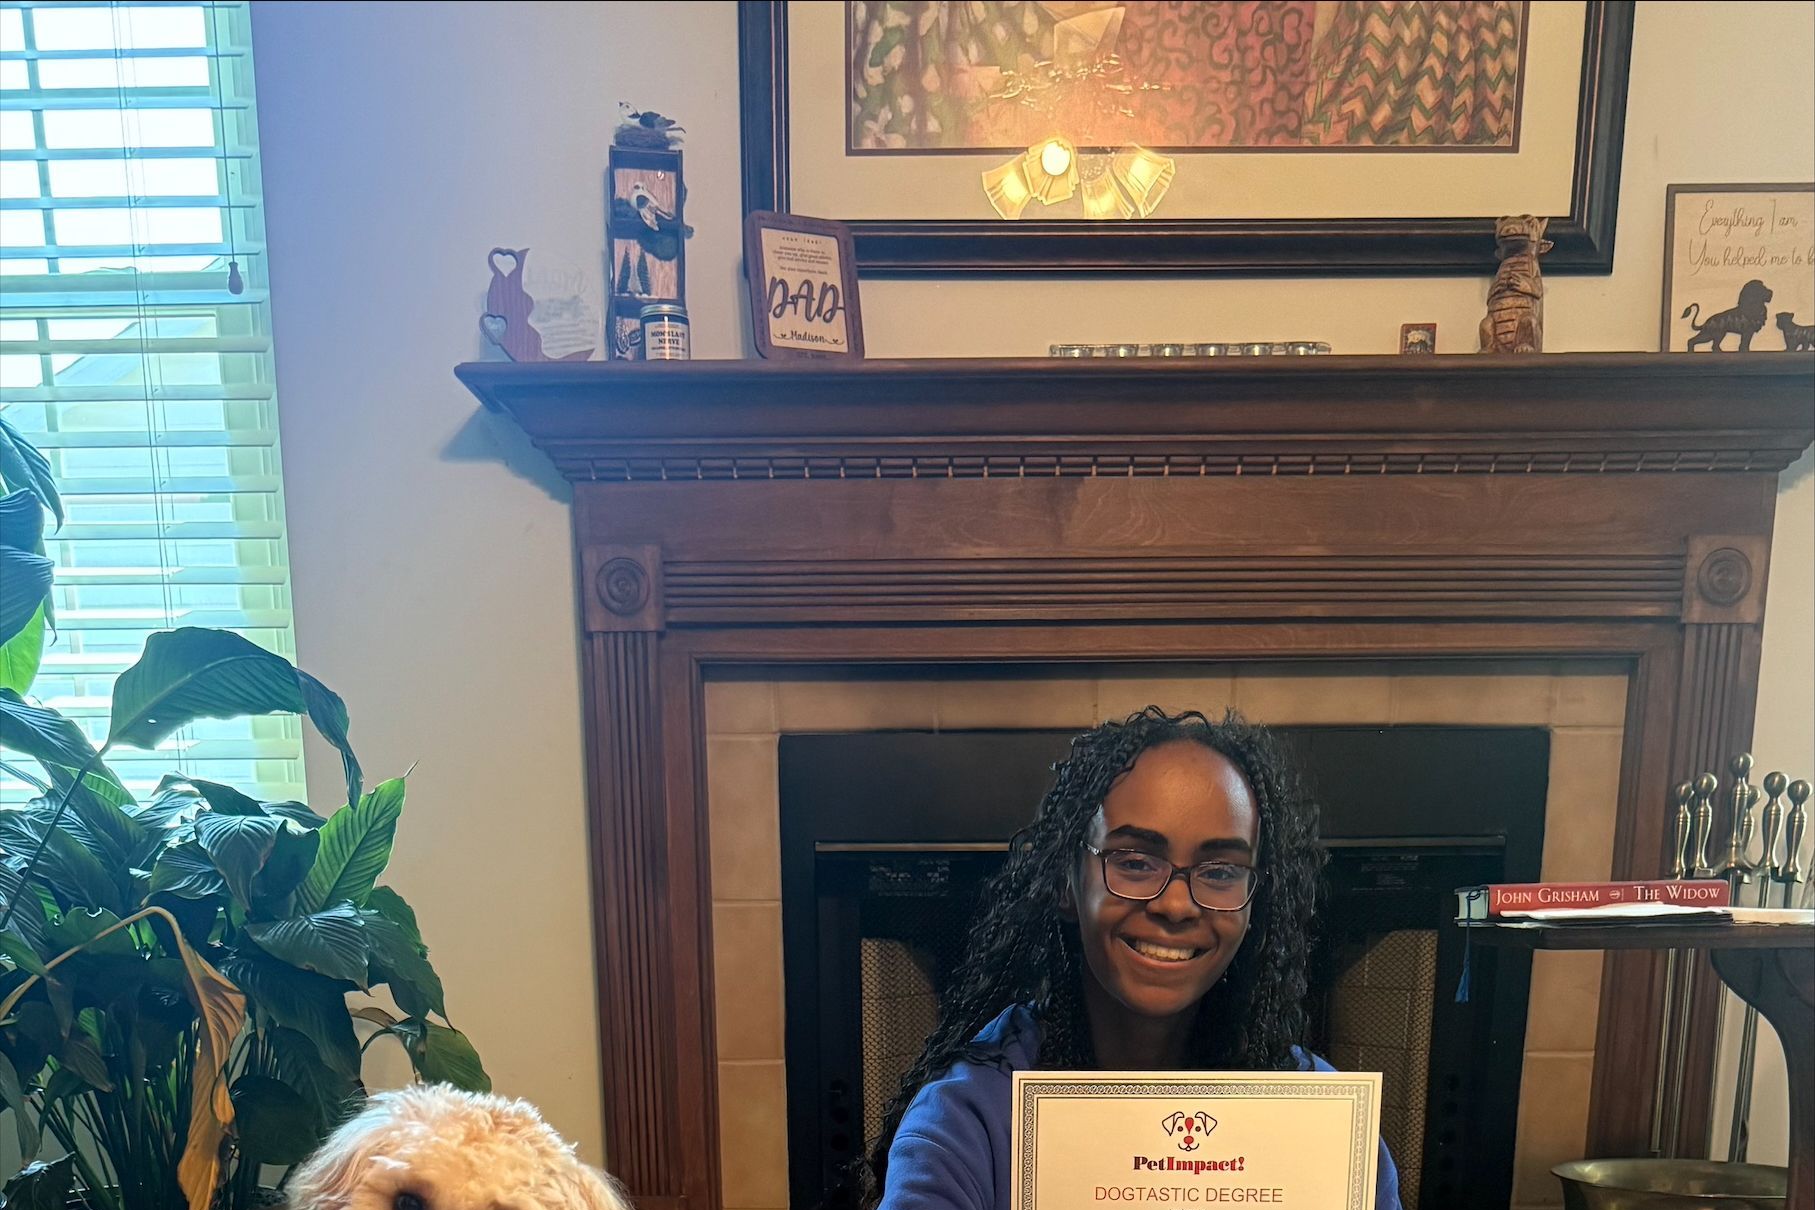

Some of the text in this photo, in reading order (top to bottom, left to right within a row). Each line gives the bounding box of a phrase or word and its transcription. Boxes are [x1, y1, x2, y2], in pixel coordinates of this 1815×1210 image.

[1698, 199, 1765, 238] Everything
[1779, 216, 1799, 228] am
[1689, 239, 1720, 276] You
[1723, 246, 1767, 268] helped
[1770, 255, 1789, 265] me
[1791, 246, 1802, 265] to
[768, 276, 846, 324] DAD
[790, 329, 826, 346] Madison
[1495, 885, 1720, 905] JOHN GRISHAM THE WIDOW
[1133, 1156, 1245, 1175] PetImpact!
[1095, 1186, 1284, 1203] DOGTASTIC DEGREE
